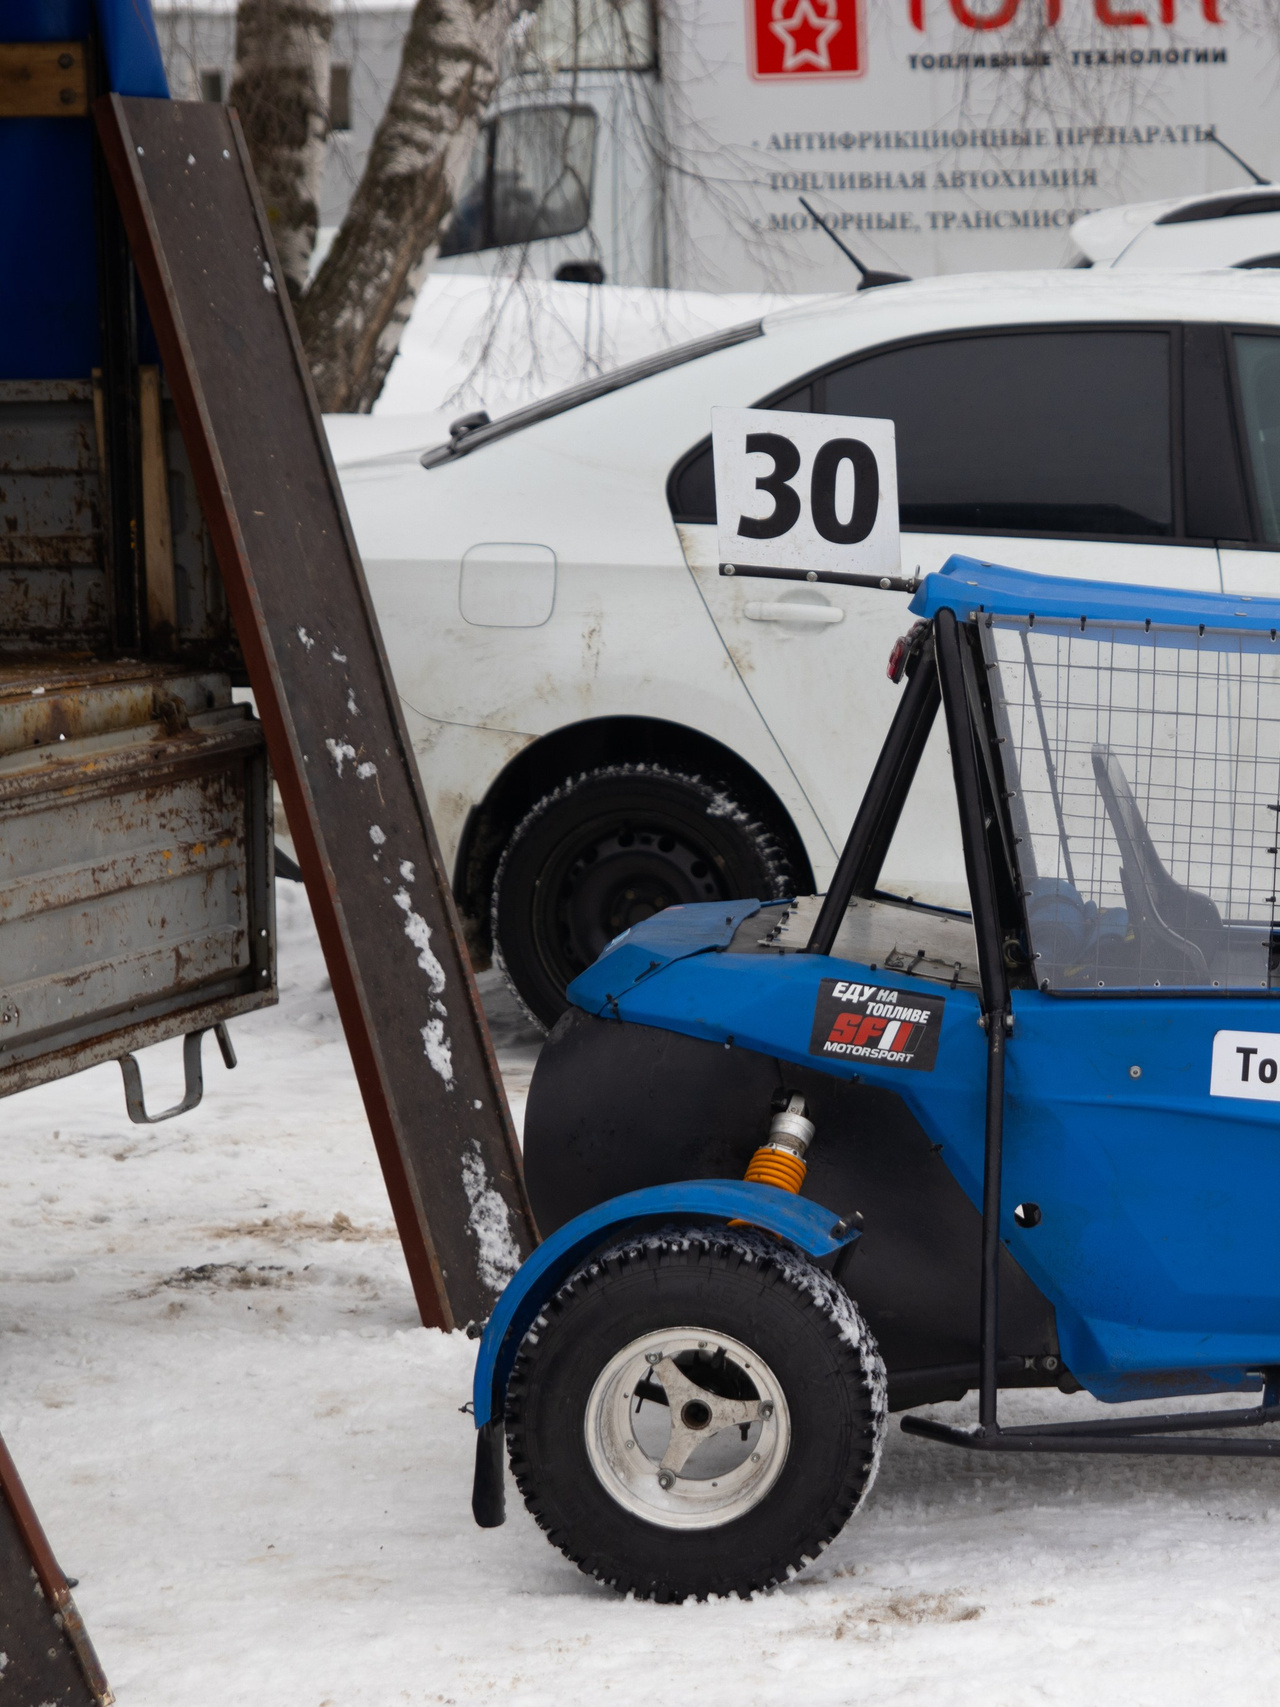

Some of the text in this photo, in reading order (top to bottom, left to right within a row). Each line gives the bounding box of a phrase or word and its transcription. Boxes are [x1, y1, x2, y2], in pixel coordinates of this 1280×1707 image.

[909, 47, 1228, 70] ТОПЛИВНЫЕ ТЕХНОЛОГИИ
[766, 124, 1217, 150] АНТИФРИКЦИОННЫЕ ПРЕПАРАТЫ
[767, 168, 1098, 191] ТОПЛИВНАЯ АВТОХИМИЯ
[769, 211, 921, 232] МОТОРНЫЕ,
[737, 432, 880, 545] 30
[832, 981, 899, 1004] ЕДУ НА
[866, 1002, 931, 1024] ТОПЛИВЕ
[823, 1041, 915, 1063] MOTORSPORT
